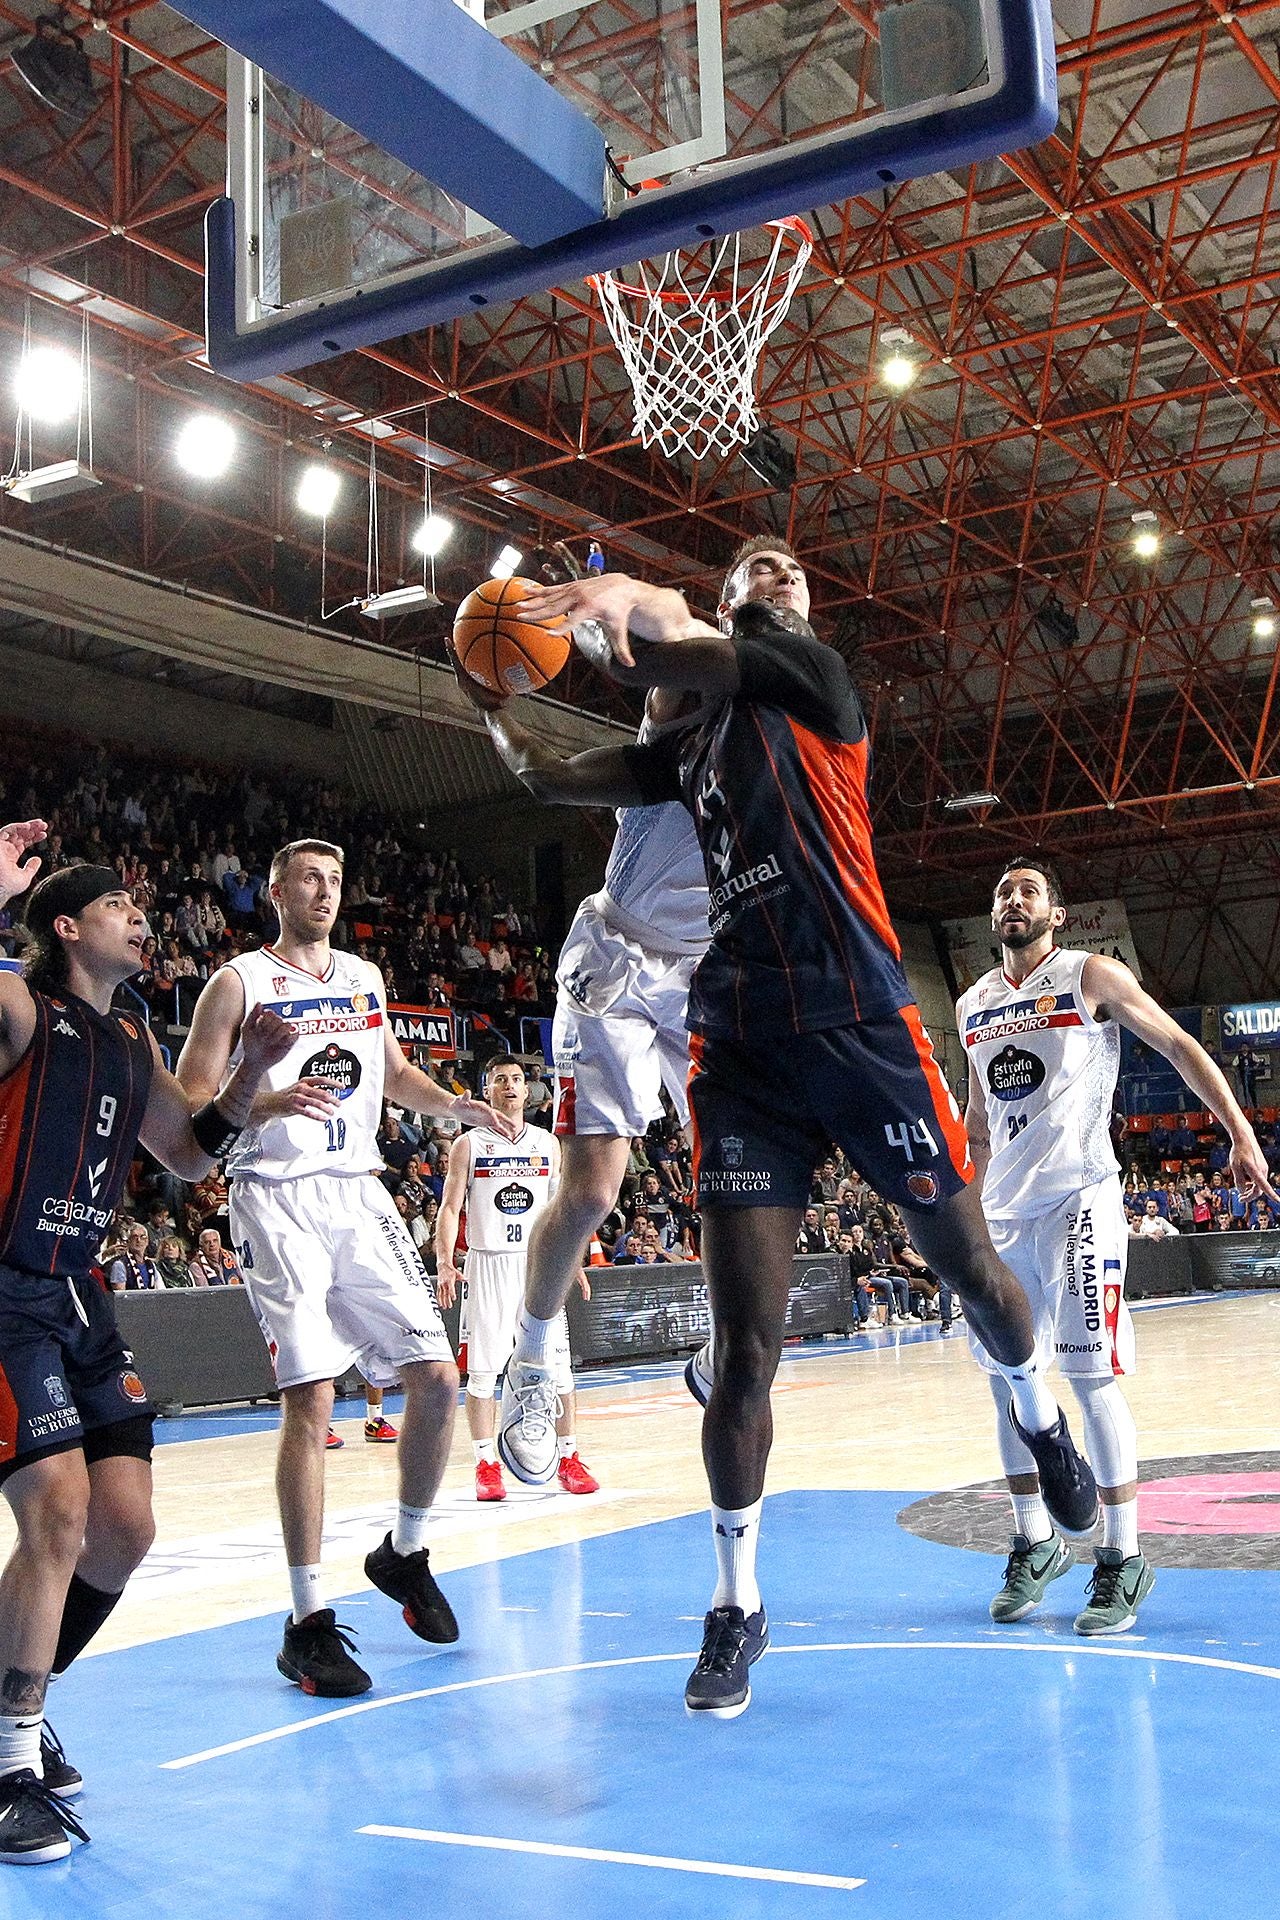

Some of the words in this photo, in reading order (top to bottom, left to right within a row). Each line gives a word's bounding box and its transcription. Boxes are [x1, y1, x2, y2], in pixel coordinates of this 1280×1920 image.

[707, 853, 784, 916] ajarural
[394, 1018, 448, 1042] AMAT
[973, 1016, 1049, 1043] OBRADOIRO
[310, 1059, 353, 1075] Estrella
[994, 1059, 1033, 1076] Estrella
[994, 1072, 1032, 1089] Galicia
[96, 1094, 117, 1138] 9
[884, 1117, 940, 1162] 44
[488, 1168, 541, 1177] OBRADOIRO
[501, 1191, 528, 1200] Estrella
[711, 1180, 771, 1192] BURGOS
[501, 1199, 527, 1208] Galicia
[36, 1218, 80, 1237] Burgos
[506, 1223, 523, 1243] 28
[1079, 1208, 1094, 1250] HEY,
[384, 1231, 420, 1288] llevamos?
[1066, 1233, 1080, 1297] llevamos?
[1081, 1254, 1101, 1332] MADRID
[31, 1425, 49, 1438] DE
